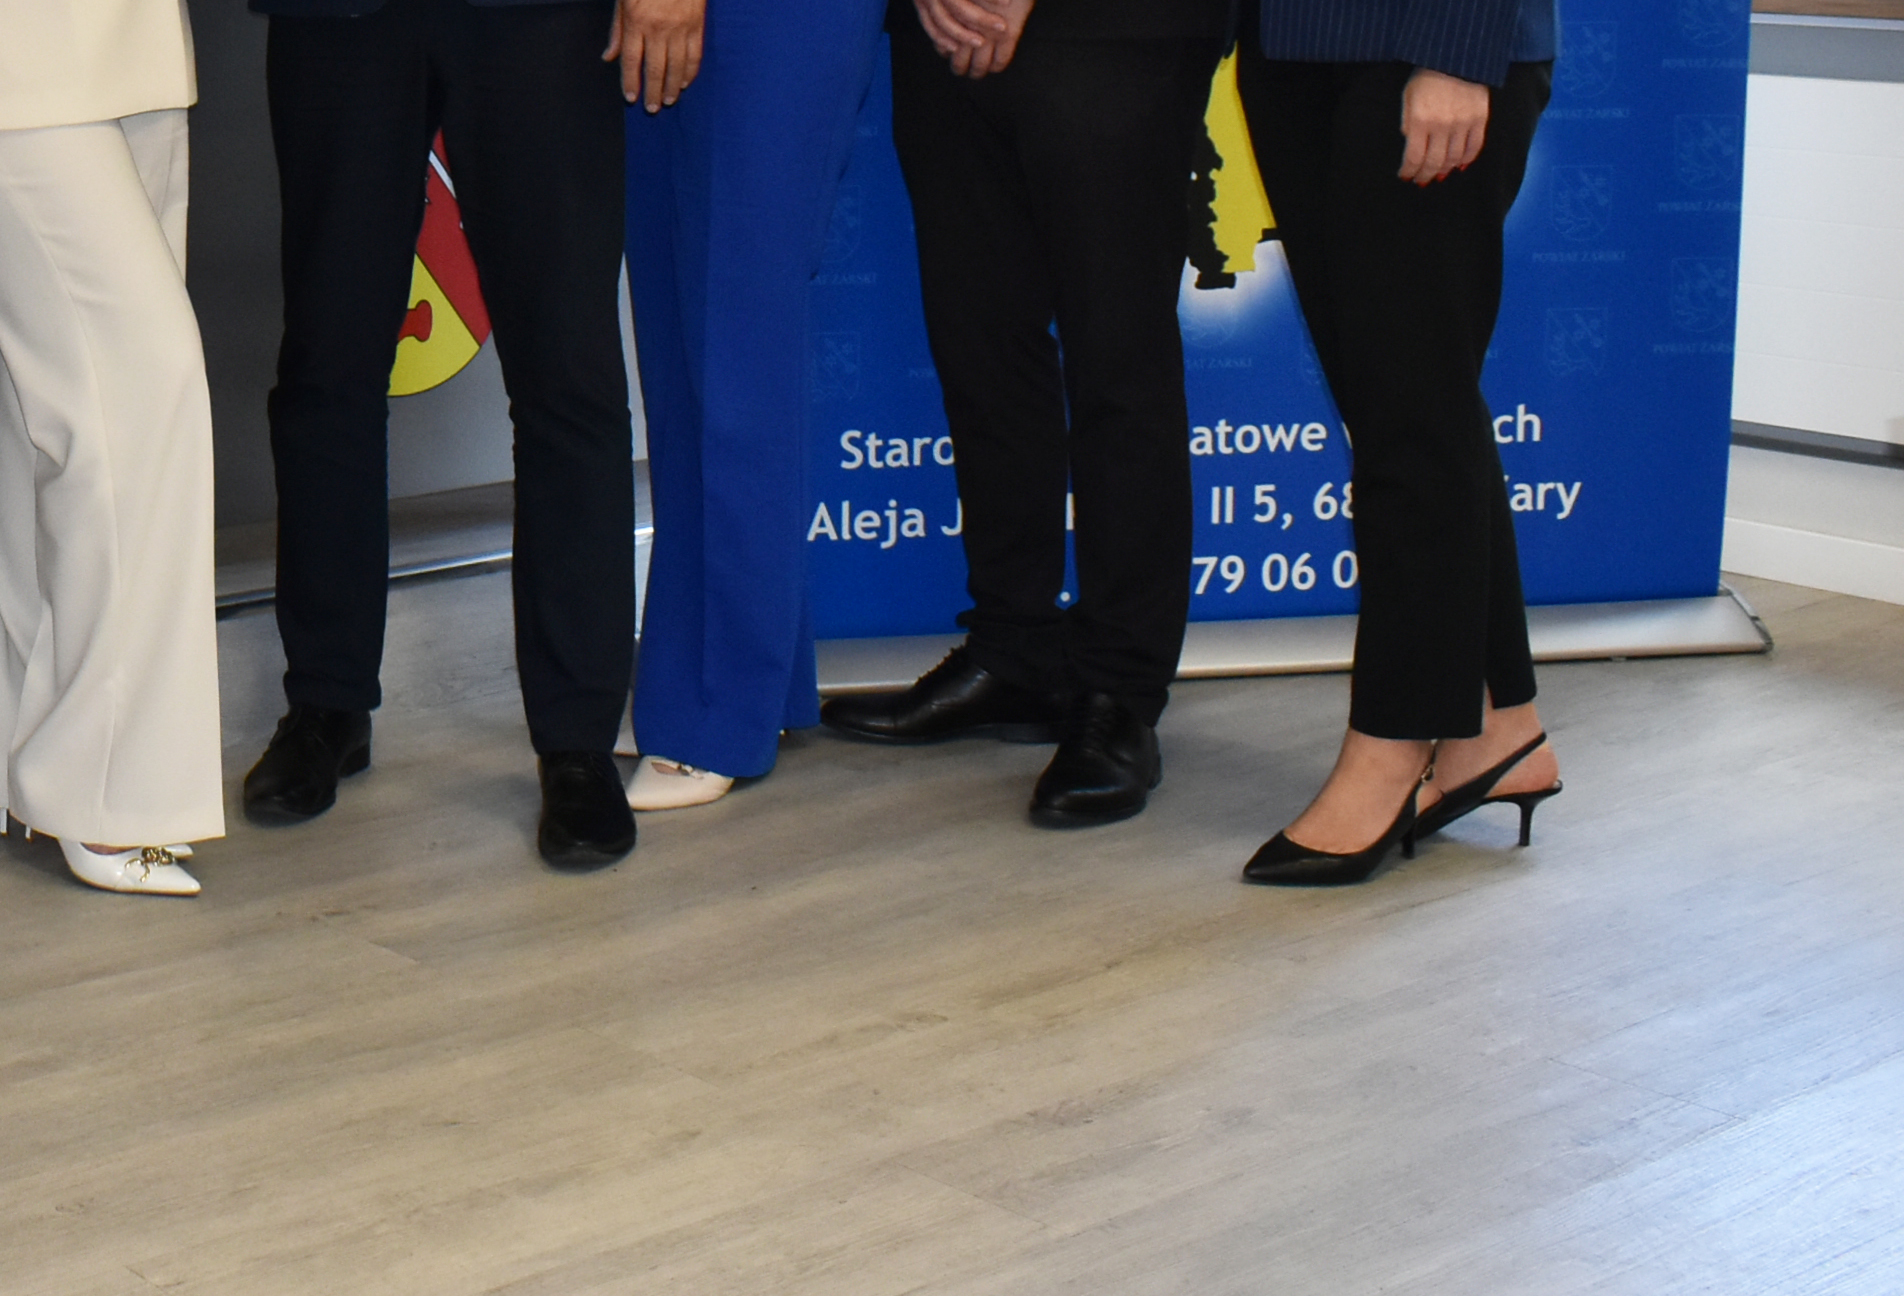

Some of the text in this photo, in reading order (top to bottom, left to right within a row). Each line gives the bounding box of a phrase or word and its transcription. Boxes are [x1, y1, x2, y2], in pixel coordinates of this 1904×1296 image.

[840, 429, 955, 469] Staro
[1189, 419, 1327, 455] atowe
[807, 499, 926, 549] Aleja
[1254, 484, 1293, 530] 5,
[1504, 475, 1582, 519] ary
[1192, 550, 1359, 595] 79 06 0
